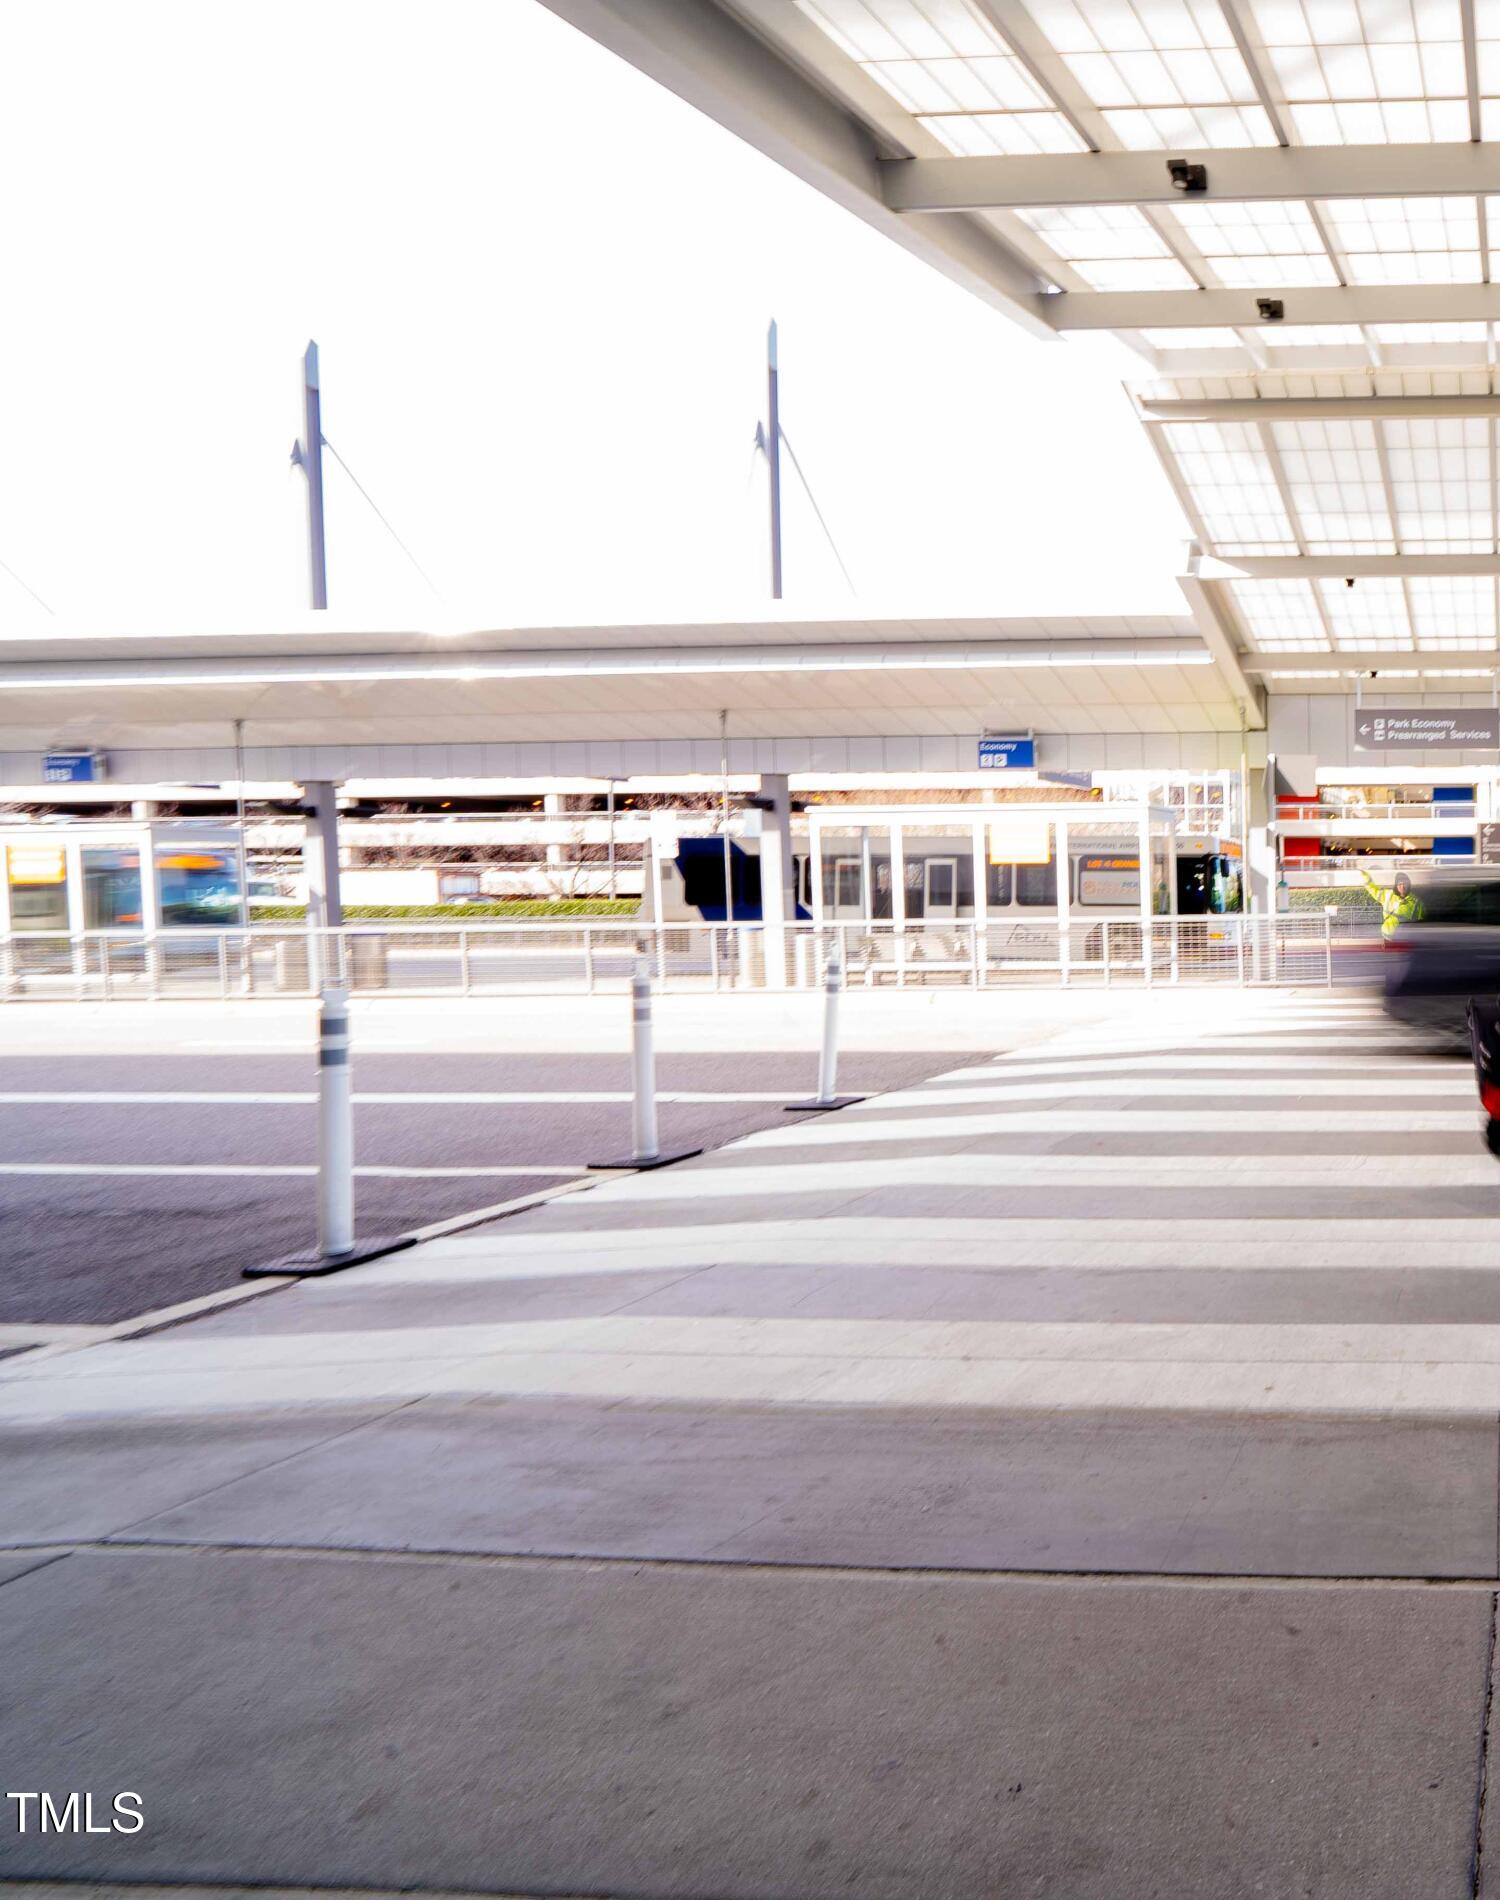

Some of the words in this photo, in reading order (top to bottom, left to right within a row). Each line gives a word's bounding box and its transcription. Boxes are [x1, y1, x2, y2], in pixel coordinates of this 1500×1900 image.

[1388, 719, 1410, 729] Park
[1412, 719, 1456, 730] Economy
[1388, 731, 1446, 742] Prearranged
[1449, 730, 1491, 740] Services
[979, 743, 1017, 752] Economy
